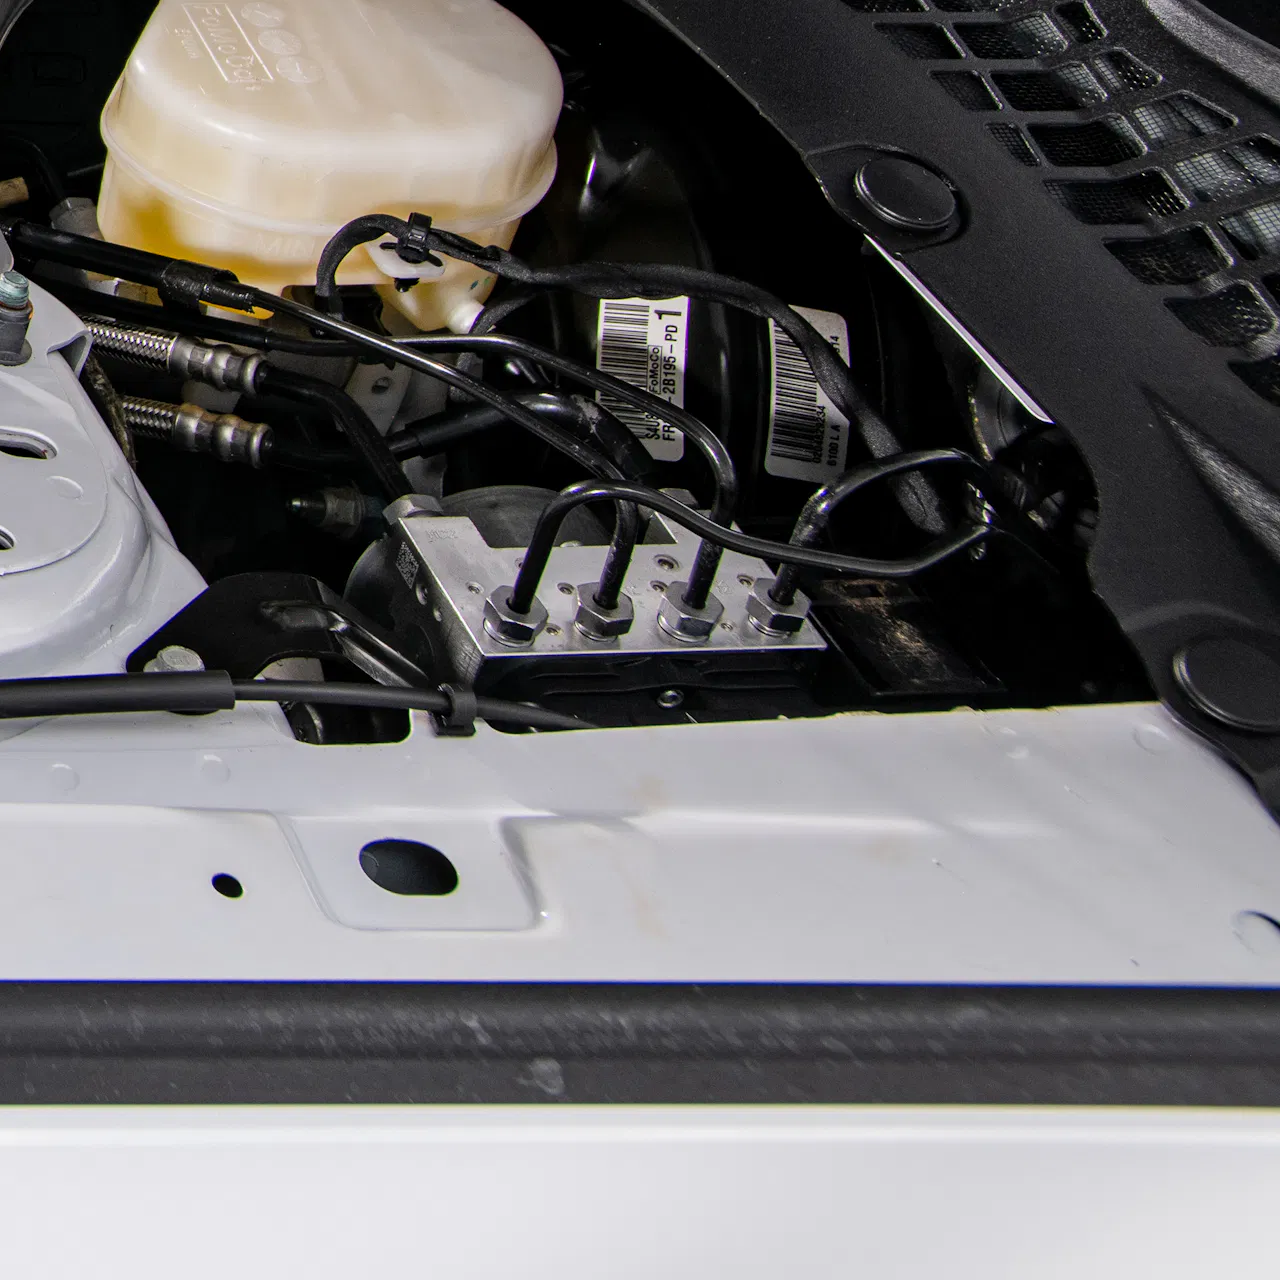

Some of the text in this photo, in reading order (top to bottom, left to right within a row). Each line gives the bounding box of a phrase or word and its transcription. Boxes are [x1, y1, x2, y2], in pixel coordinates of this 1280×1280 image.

[654, 308, 682, 320] 1
[648, 347, 661, 393] FoMoCo
[662, 324, 679, 442] FR-2B195-PD
